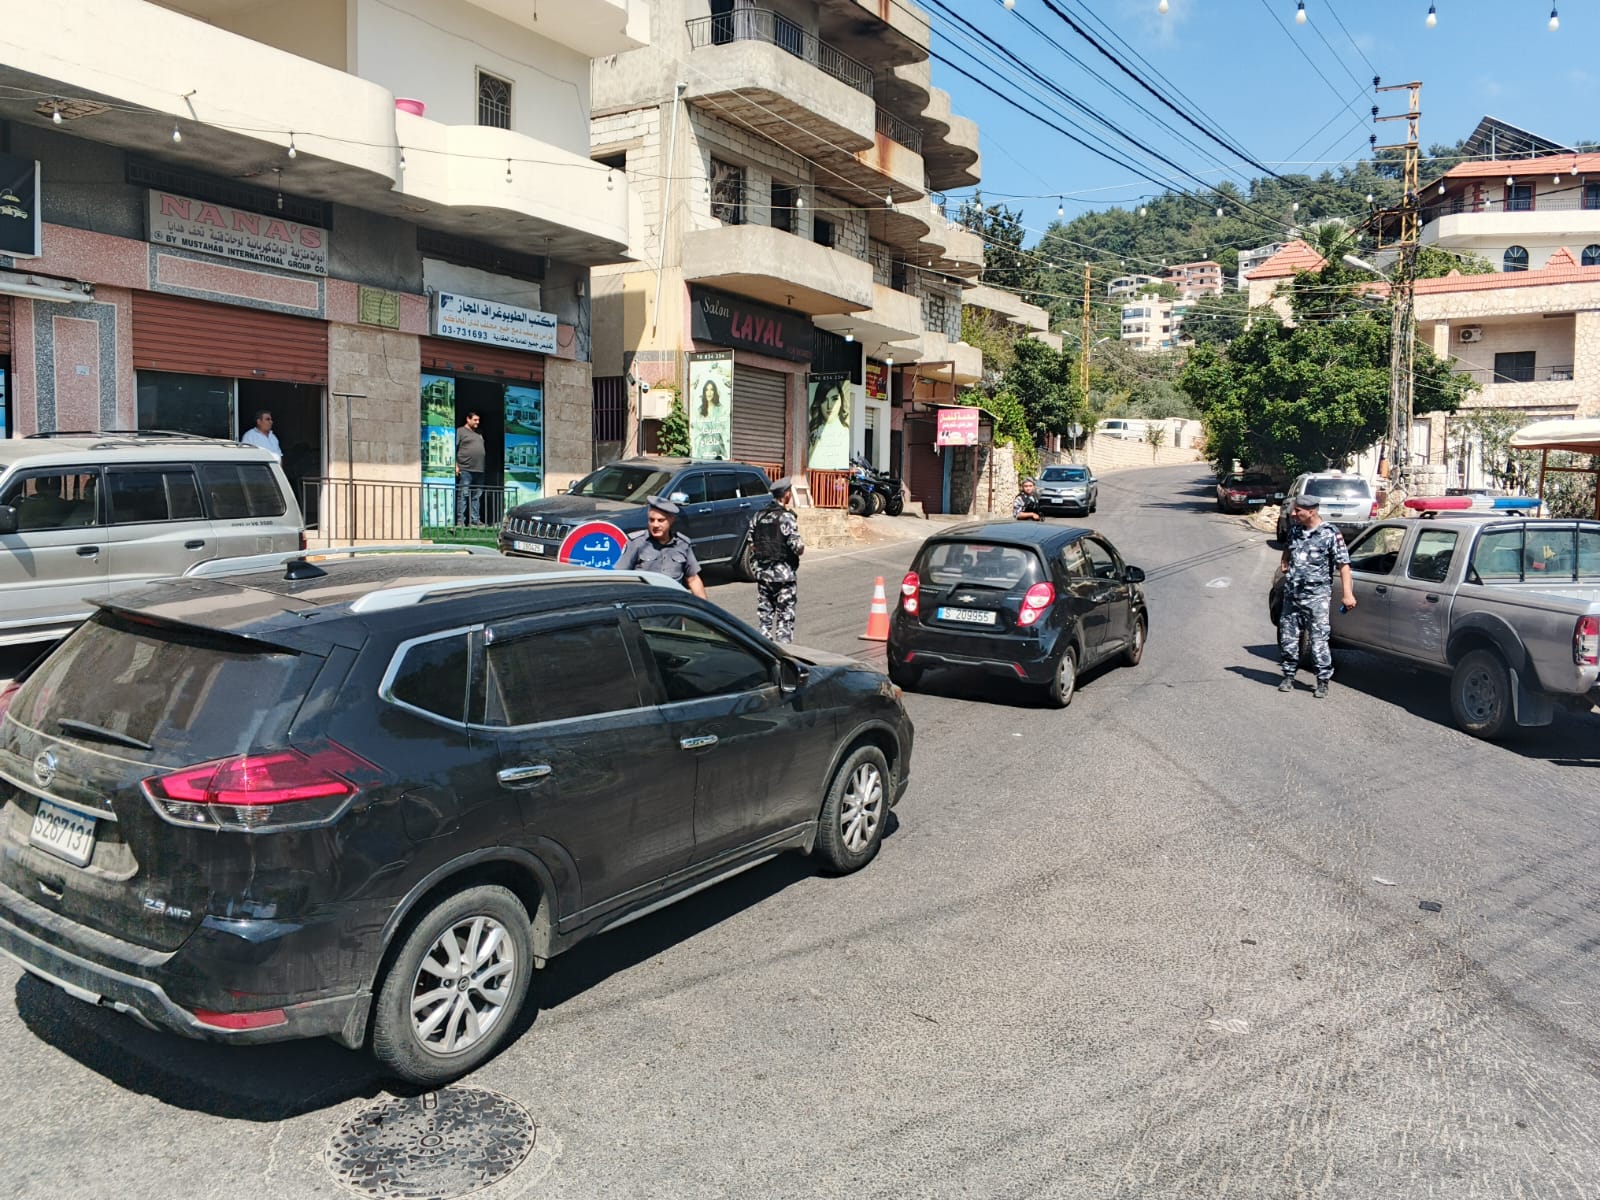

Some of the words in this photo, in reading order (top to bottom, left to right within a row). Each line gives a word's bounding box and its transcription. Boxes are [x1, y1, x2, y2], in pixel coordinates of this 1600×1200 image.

[160, 194, 322, 249] NANA'S
[165, 234, 177, 244] BY
[181, 237, 224, 253] MUSTAHAB
[227, 248, 284, 266] INTERNATIONAL
[287, 259, 311, 271] GROUP
[314, 265, 327, 274] CO.
[703, 296, 729, 318] Salon
[528, 314, 556, 328] مكتب
[442, 324, 488, 340] 03-731693
[731, 311, 784, 348] LAYAL
[584, 537, 610, 552] قف
[580, 556, 595, 567] أمن
[595, 557, 611, 568] قوى
[944, 609, 950, 618] S
[956, 609, 989, 622] 209955
[34, 809, 93, 856] S267131
